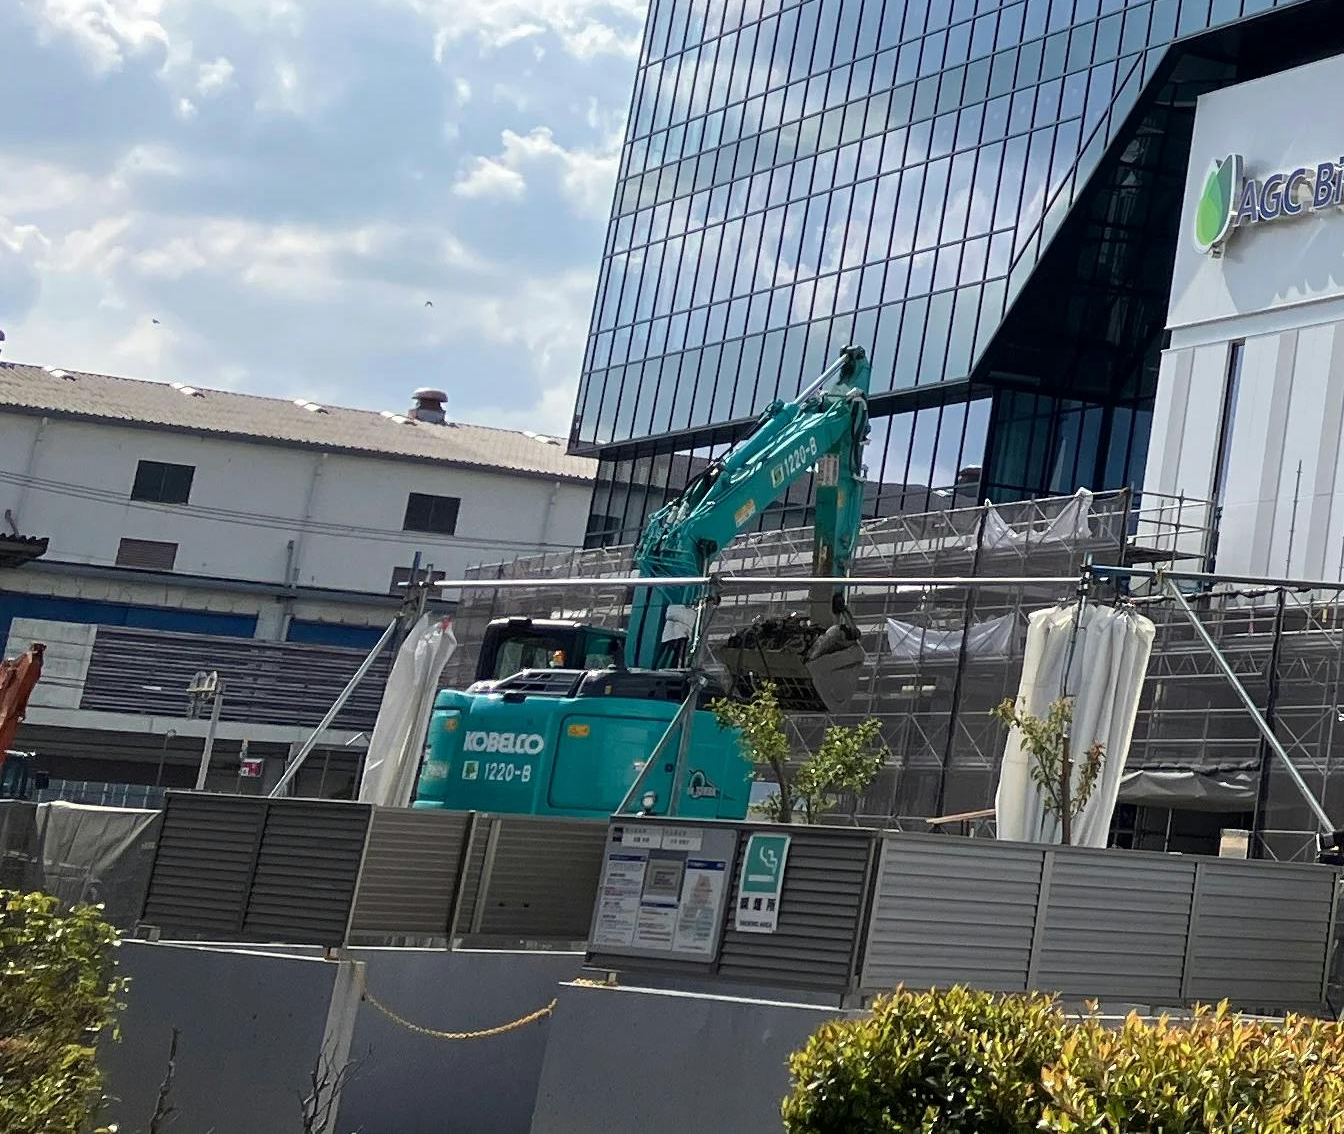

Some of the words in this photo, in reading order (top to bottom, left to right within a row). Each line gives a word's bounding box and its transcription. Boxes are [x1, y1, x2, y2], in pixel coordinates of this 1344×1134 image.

[1235, 168, 1306, 227] AGC
[463, 730, 545, 755] KOBELCO
[484, 762, 532, 783] 1220-B
